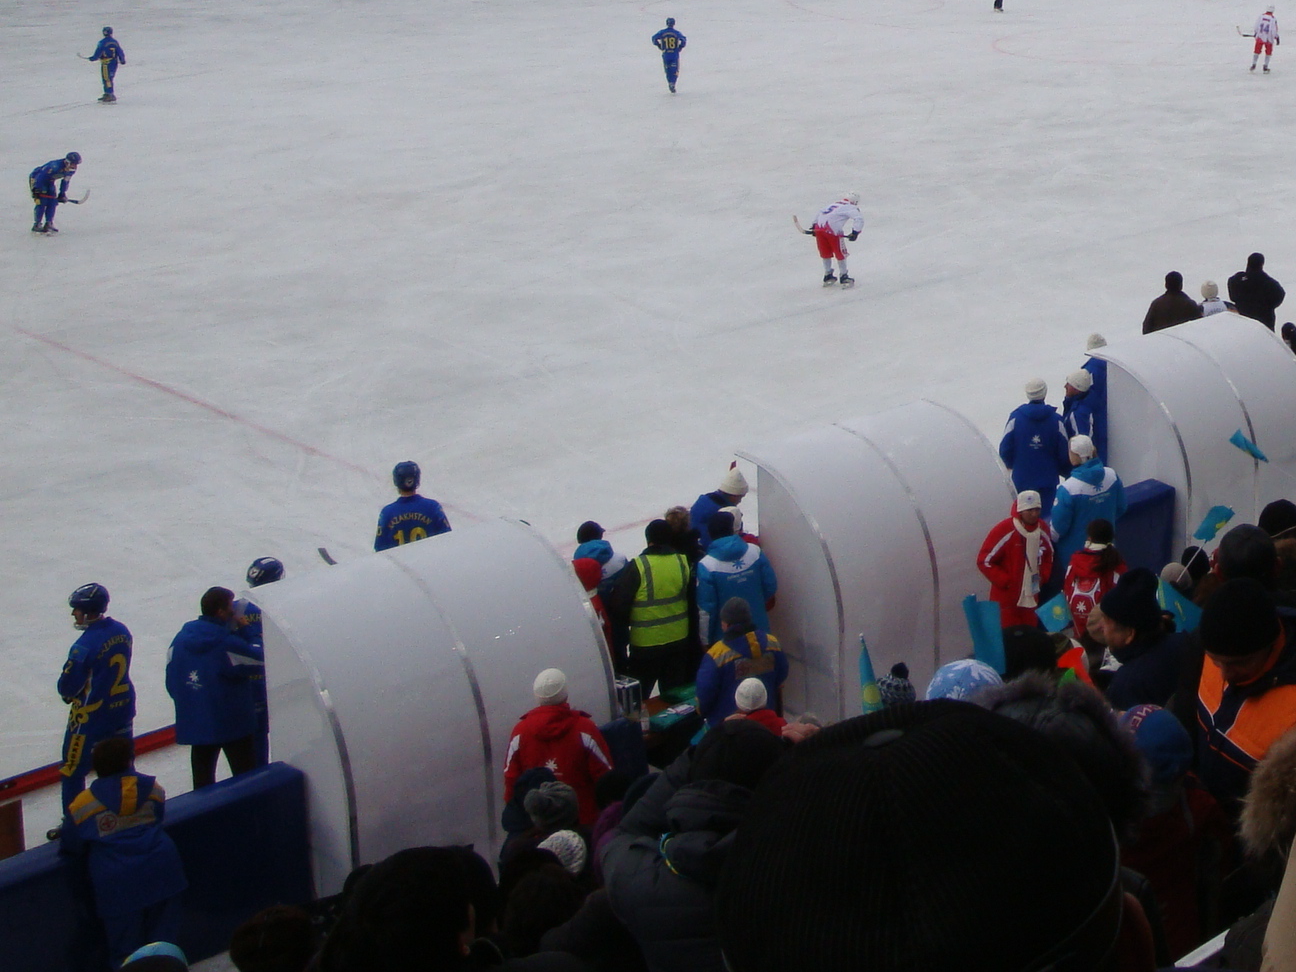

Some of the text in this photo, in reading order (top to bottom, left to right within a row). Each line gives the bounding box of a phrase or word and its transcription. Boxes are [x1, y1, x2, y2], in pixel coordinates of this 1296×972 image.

[1260, 23, 1270, 34] 14
[664, 37, 676, 49] 18
[64, 660, 73, 674] 2
[108, 653, 129, 697] 2
